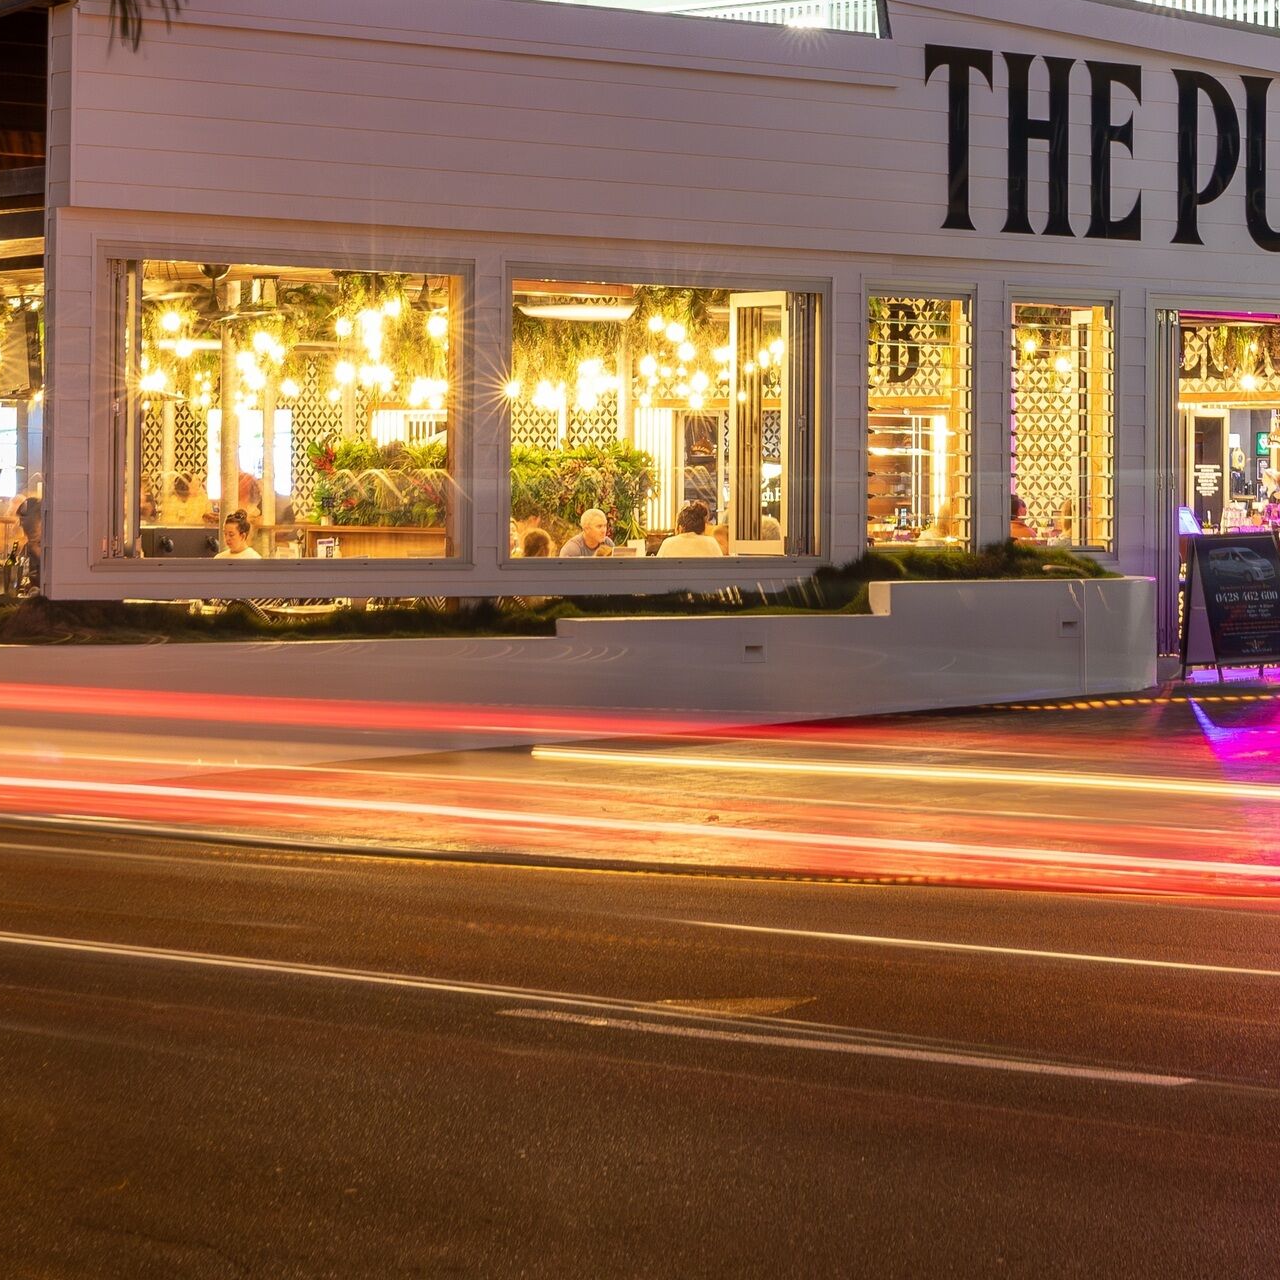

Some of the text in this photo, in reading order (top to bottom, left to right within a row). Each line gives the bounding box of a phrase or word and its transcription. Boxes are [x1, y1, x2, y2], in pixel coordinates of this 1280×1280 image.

[924, 43, 1142, 241] THE
[1215, 590, 1278, 603] 0428 462 600
